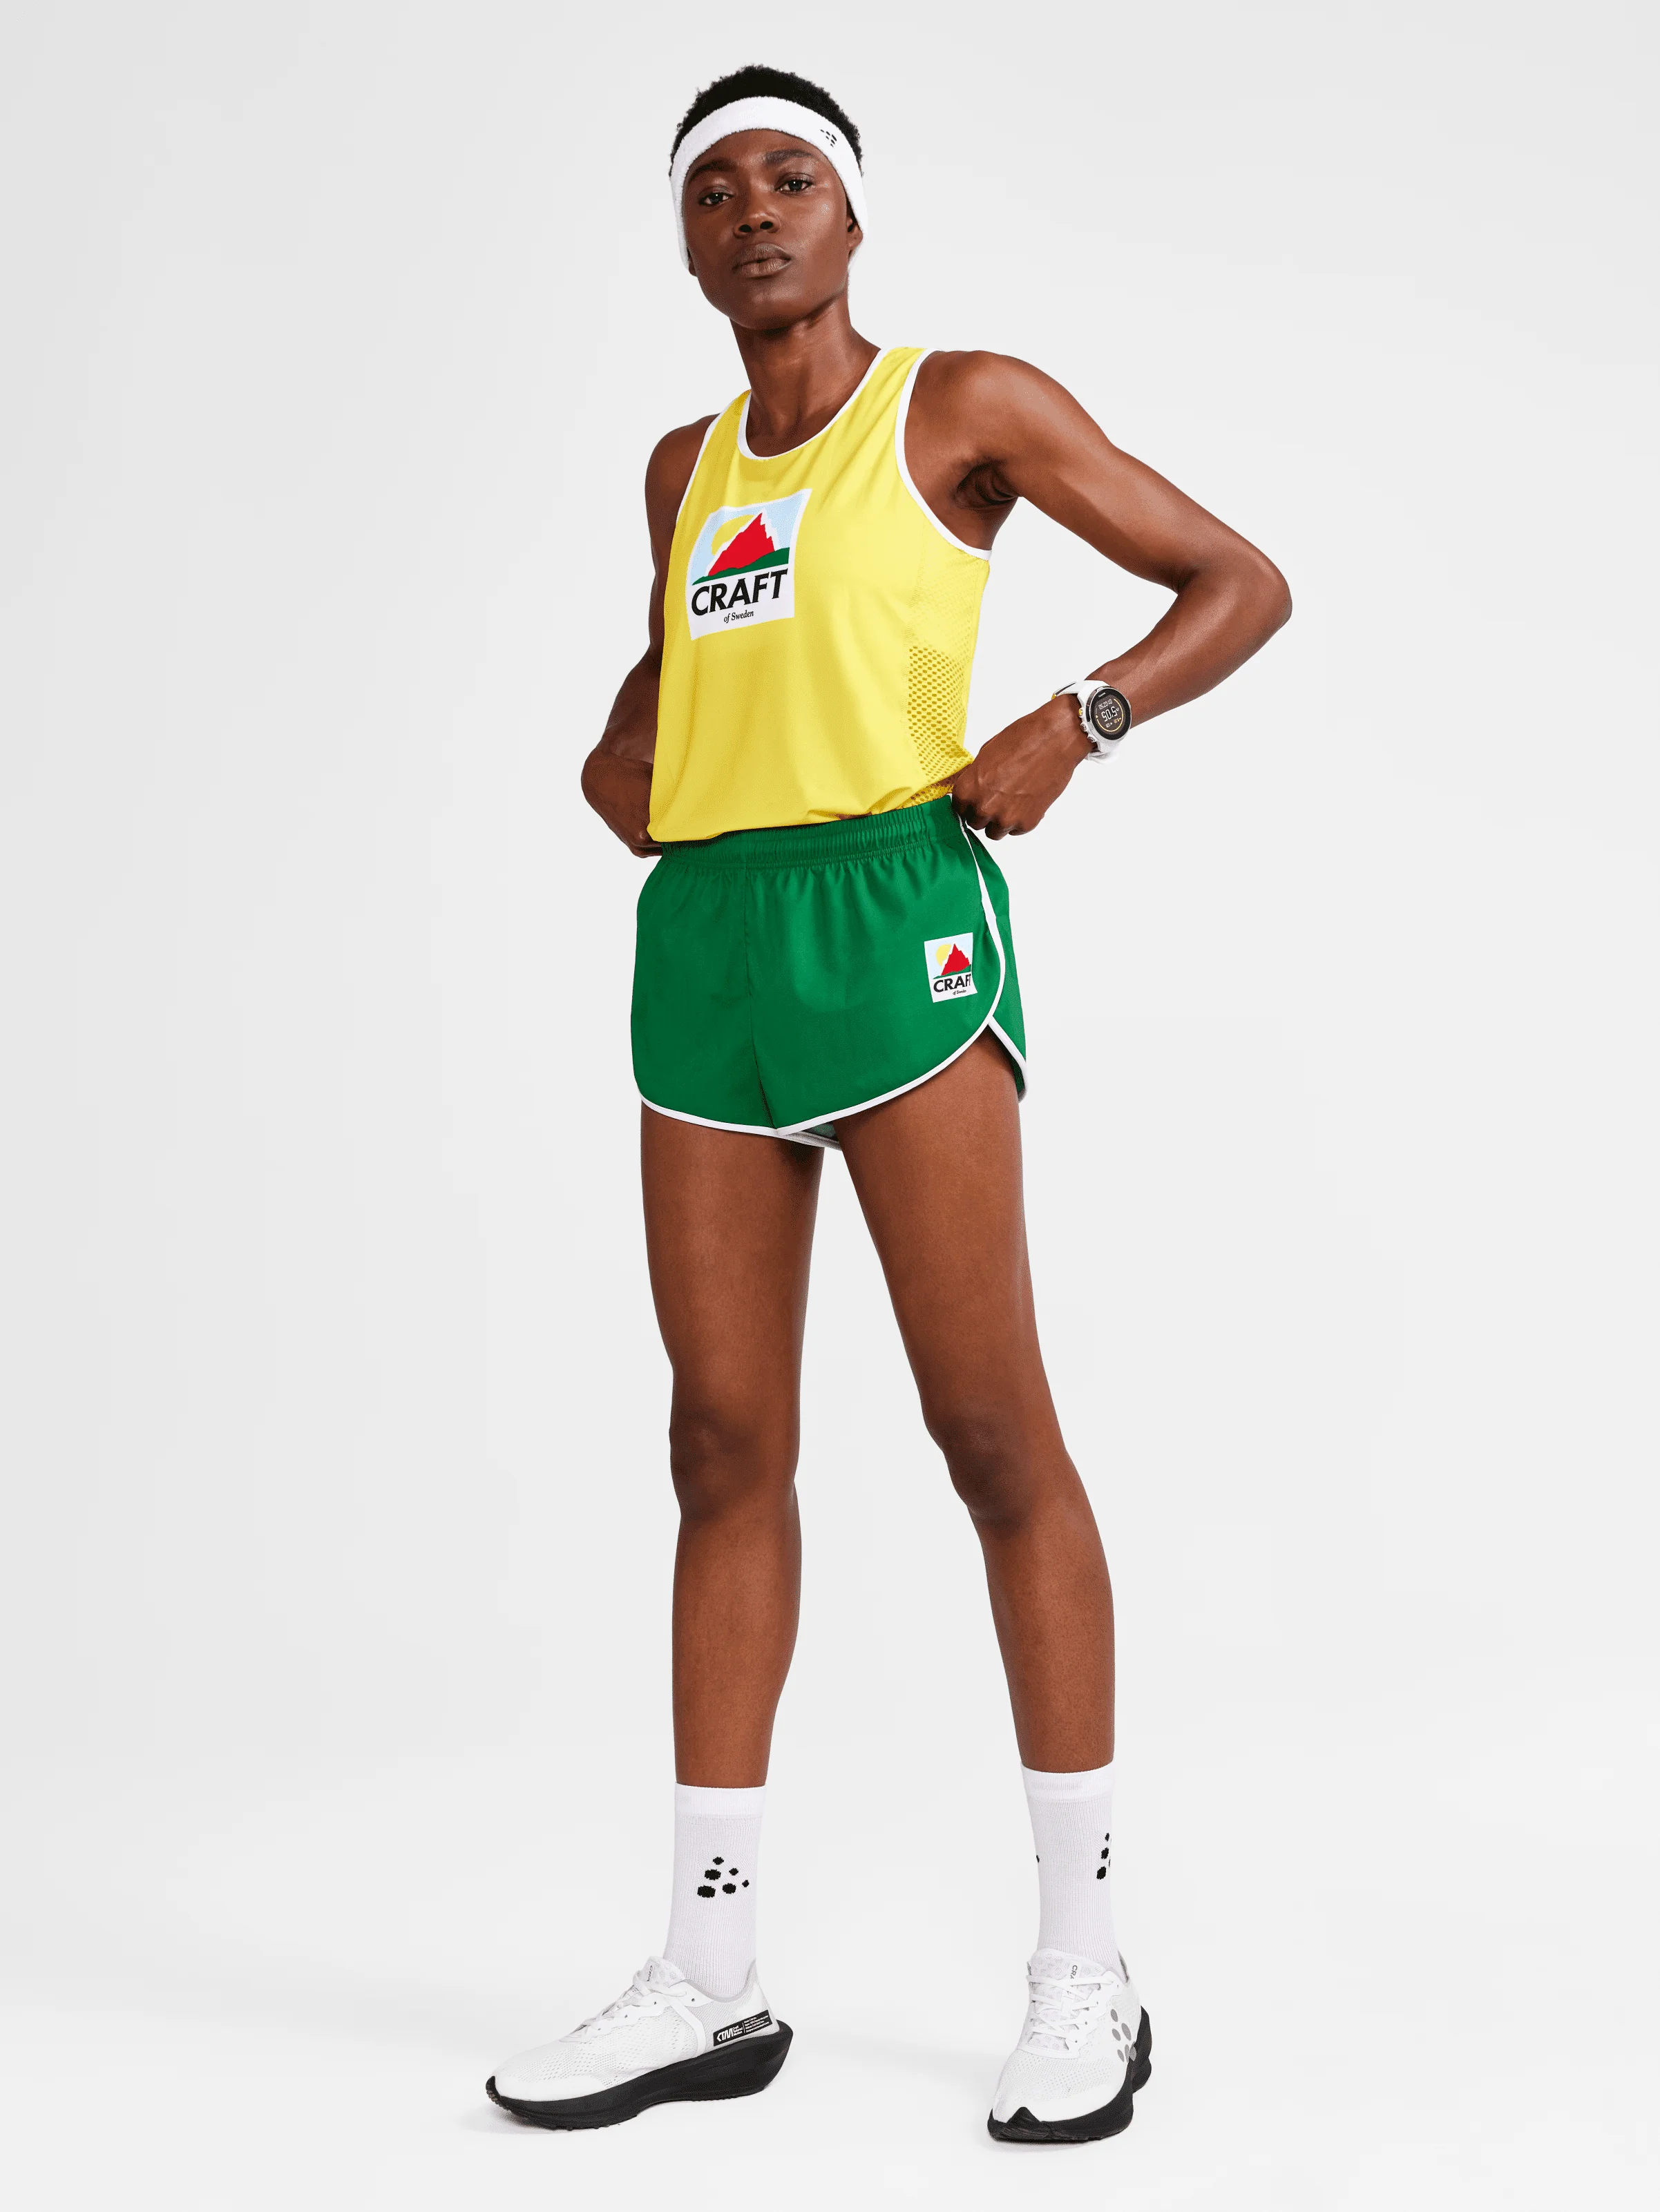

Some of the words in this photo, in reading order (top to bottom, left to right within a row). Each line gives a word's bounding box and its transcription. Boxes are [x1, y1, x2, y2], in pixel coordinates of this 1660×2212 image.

[691, 568, 788, 616] CRAFT
[724, 613, 730, 623] of
[732, 610, 754, 620] Sweden
